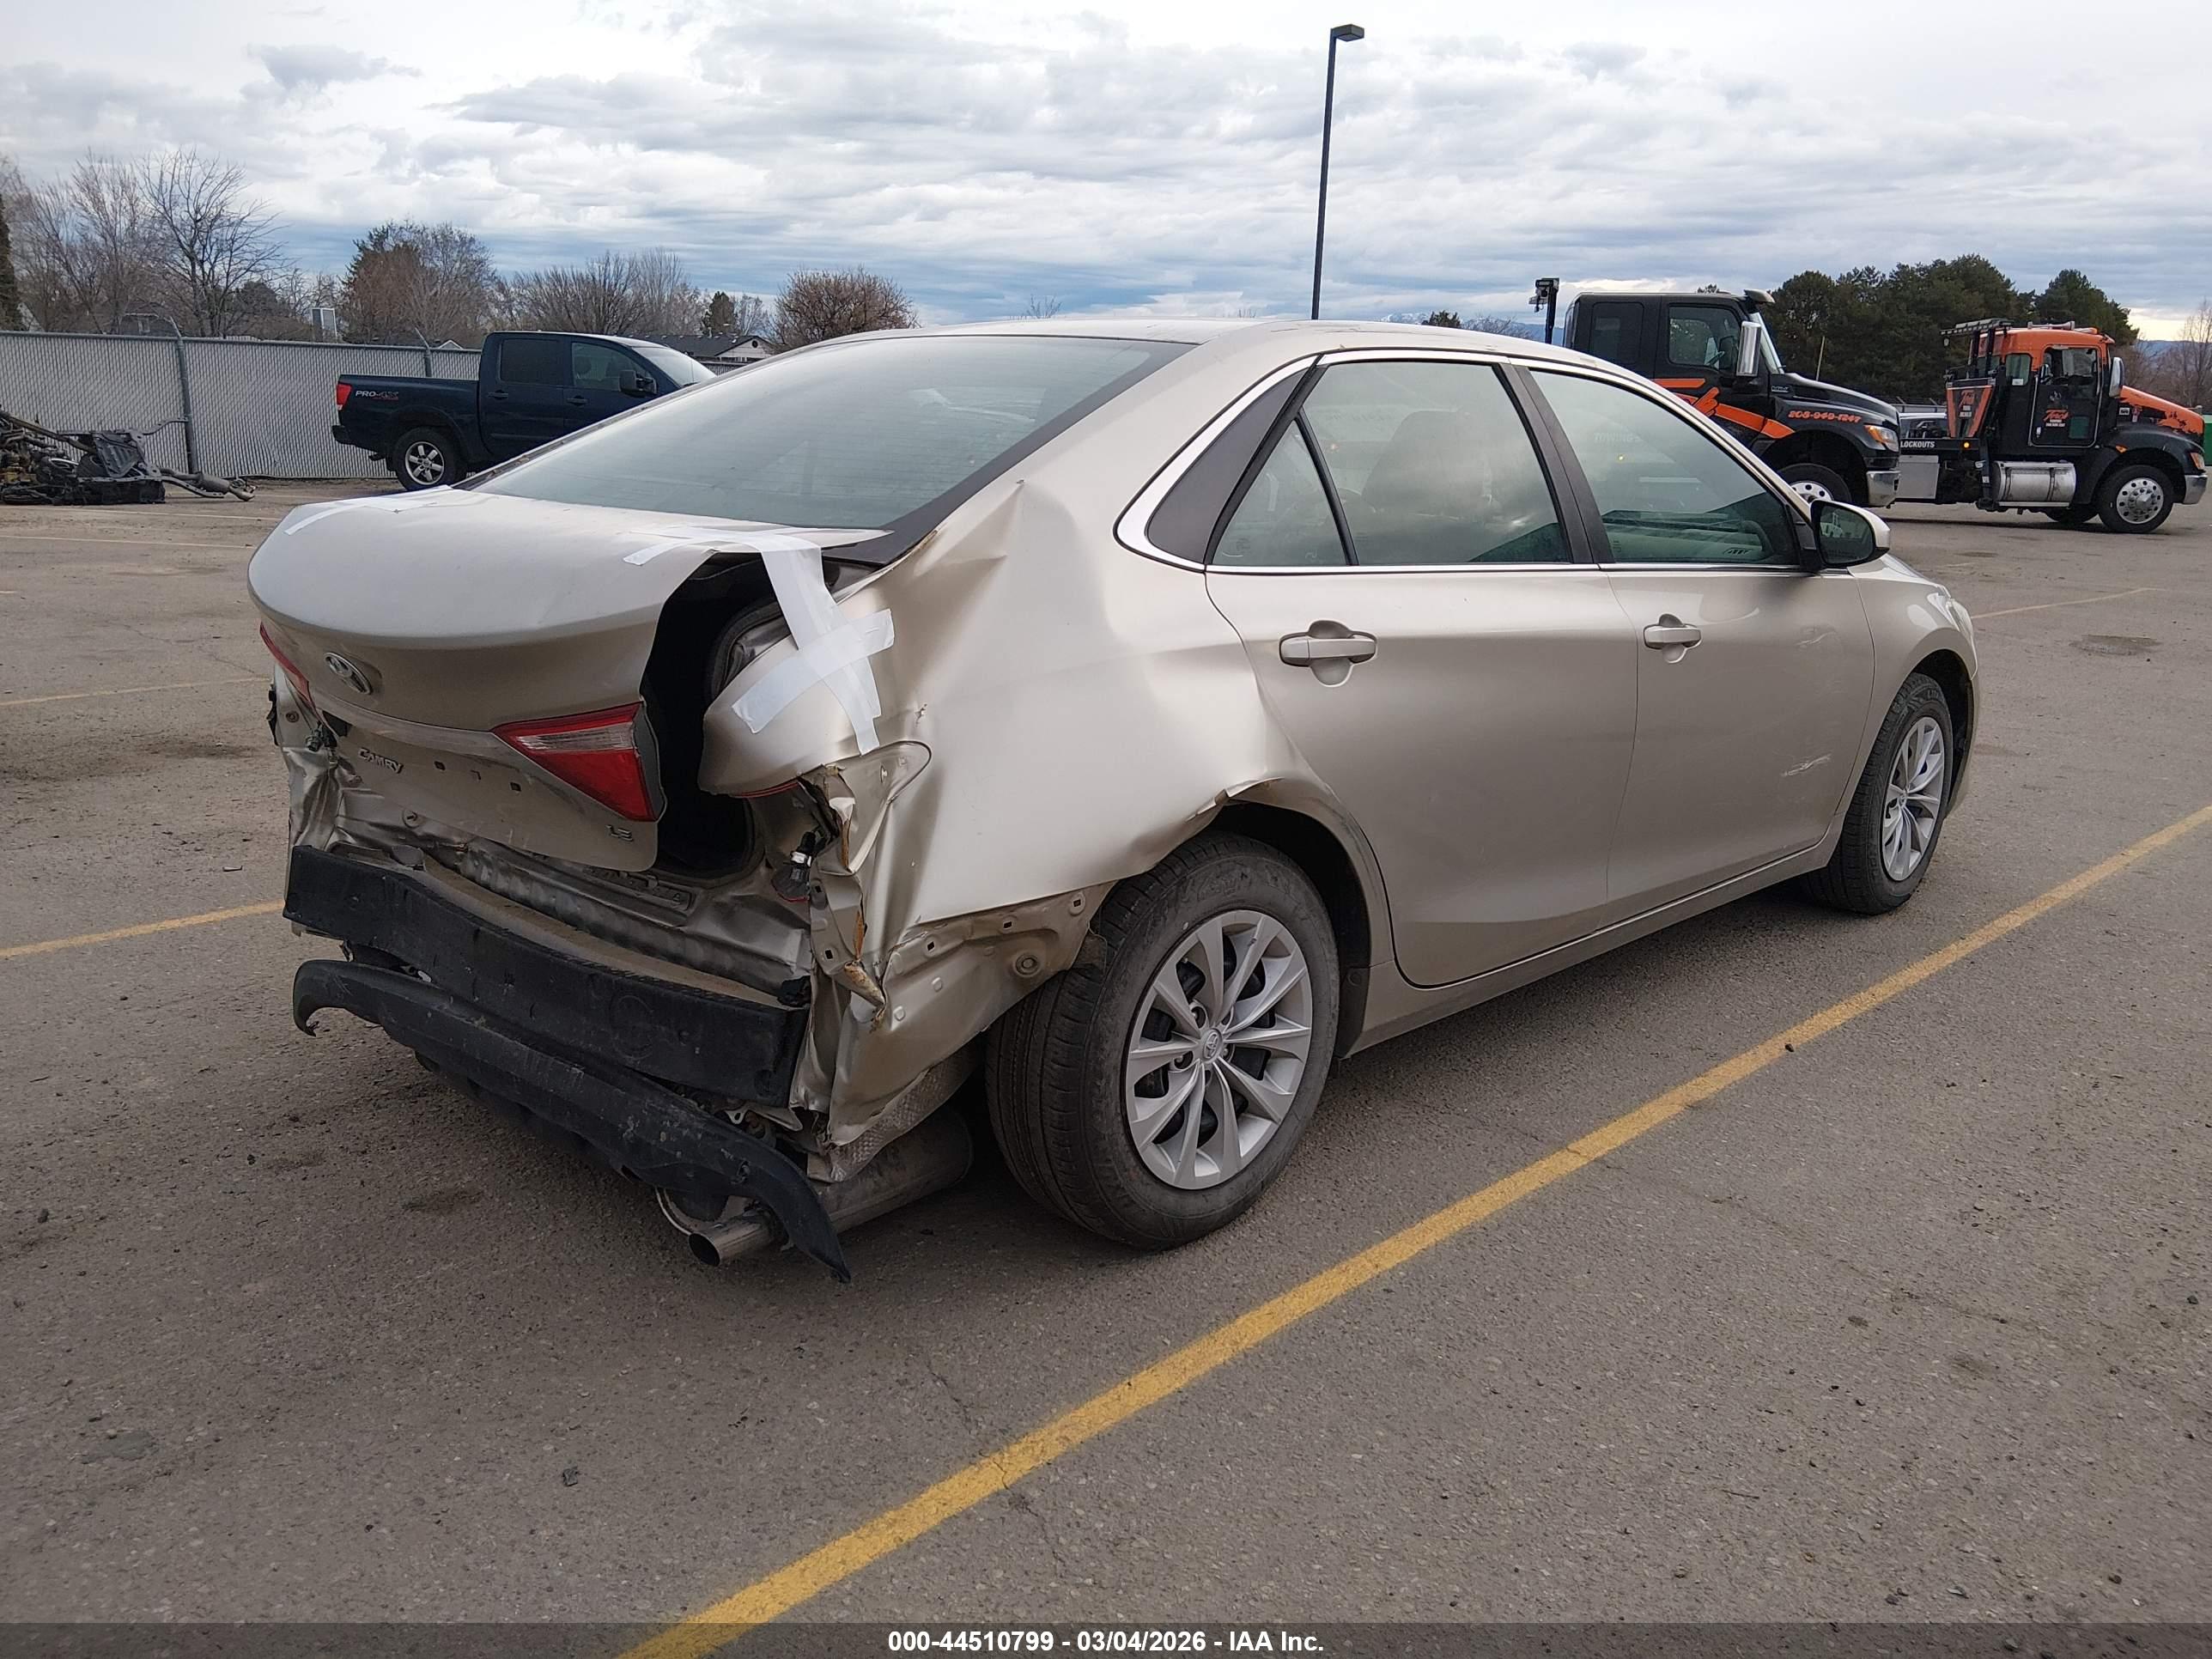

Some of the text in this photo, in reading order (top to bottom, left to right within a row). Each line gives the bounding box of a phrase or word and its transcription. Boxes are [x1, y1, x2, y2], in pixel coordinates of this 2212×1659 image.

[355, 390, 399, 399] PRO-4X
[1899, 440, 1936, 448] LOCKOUTS
[357, 746, 404, 774] CAMRY
[604, 823, 634, 840] LE
